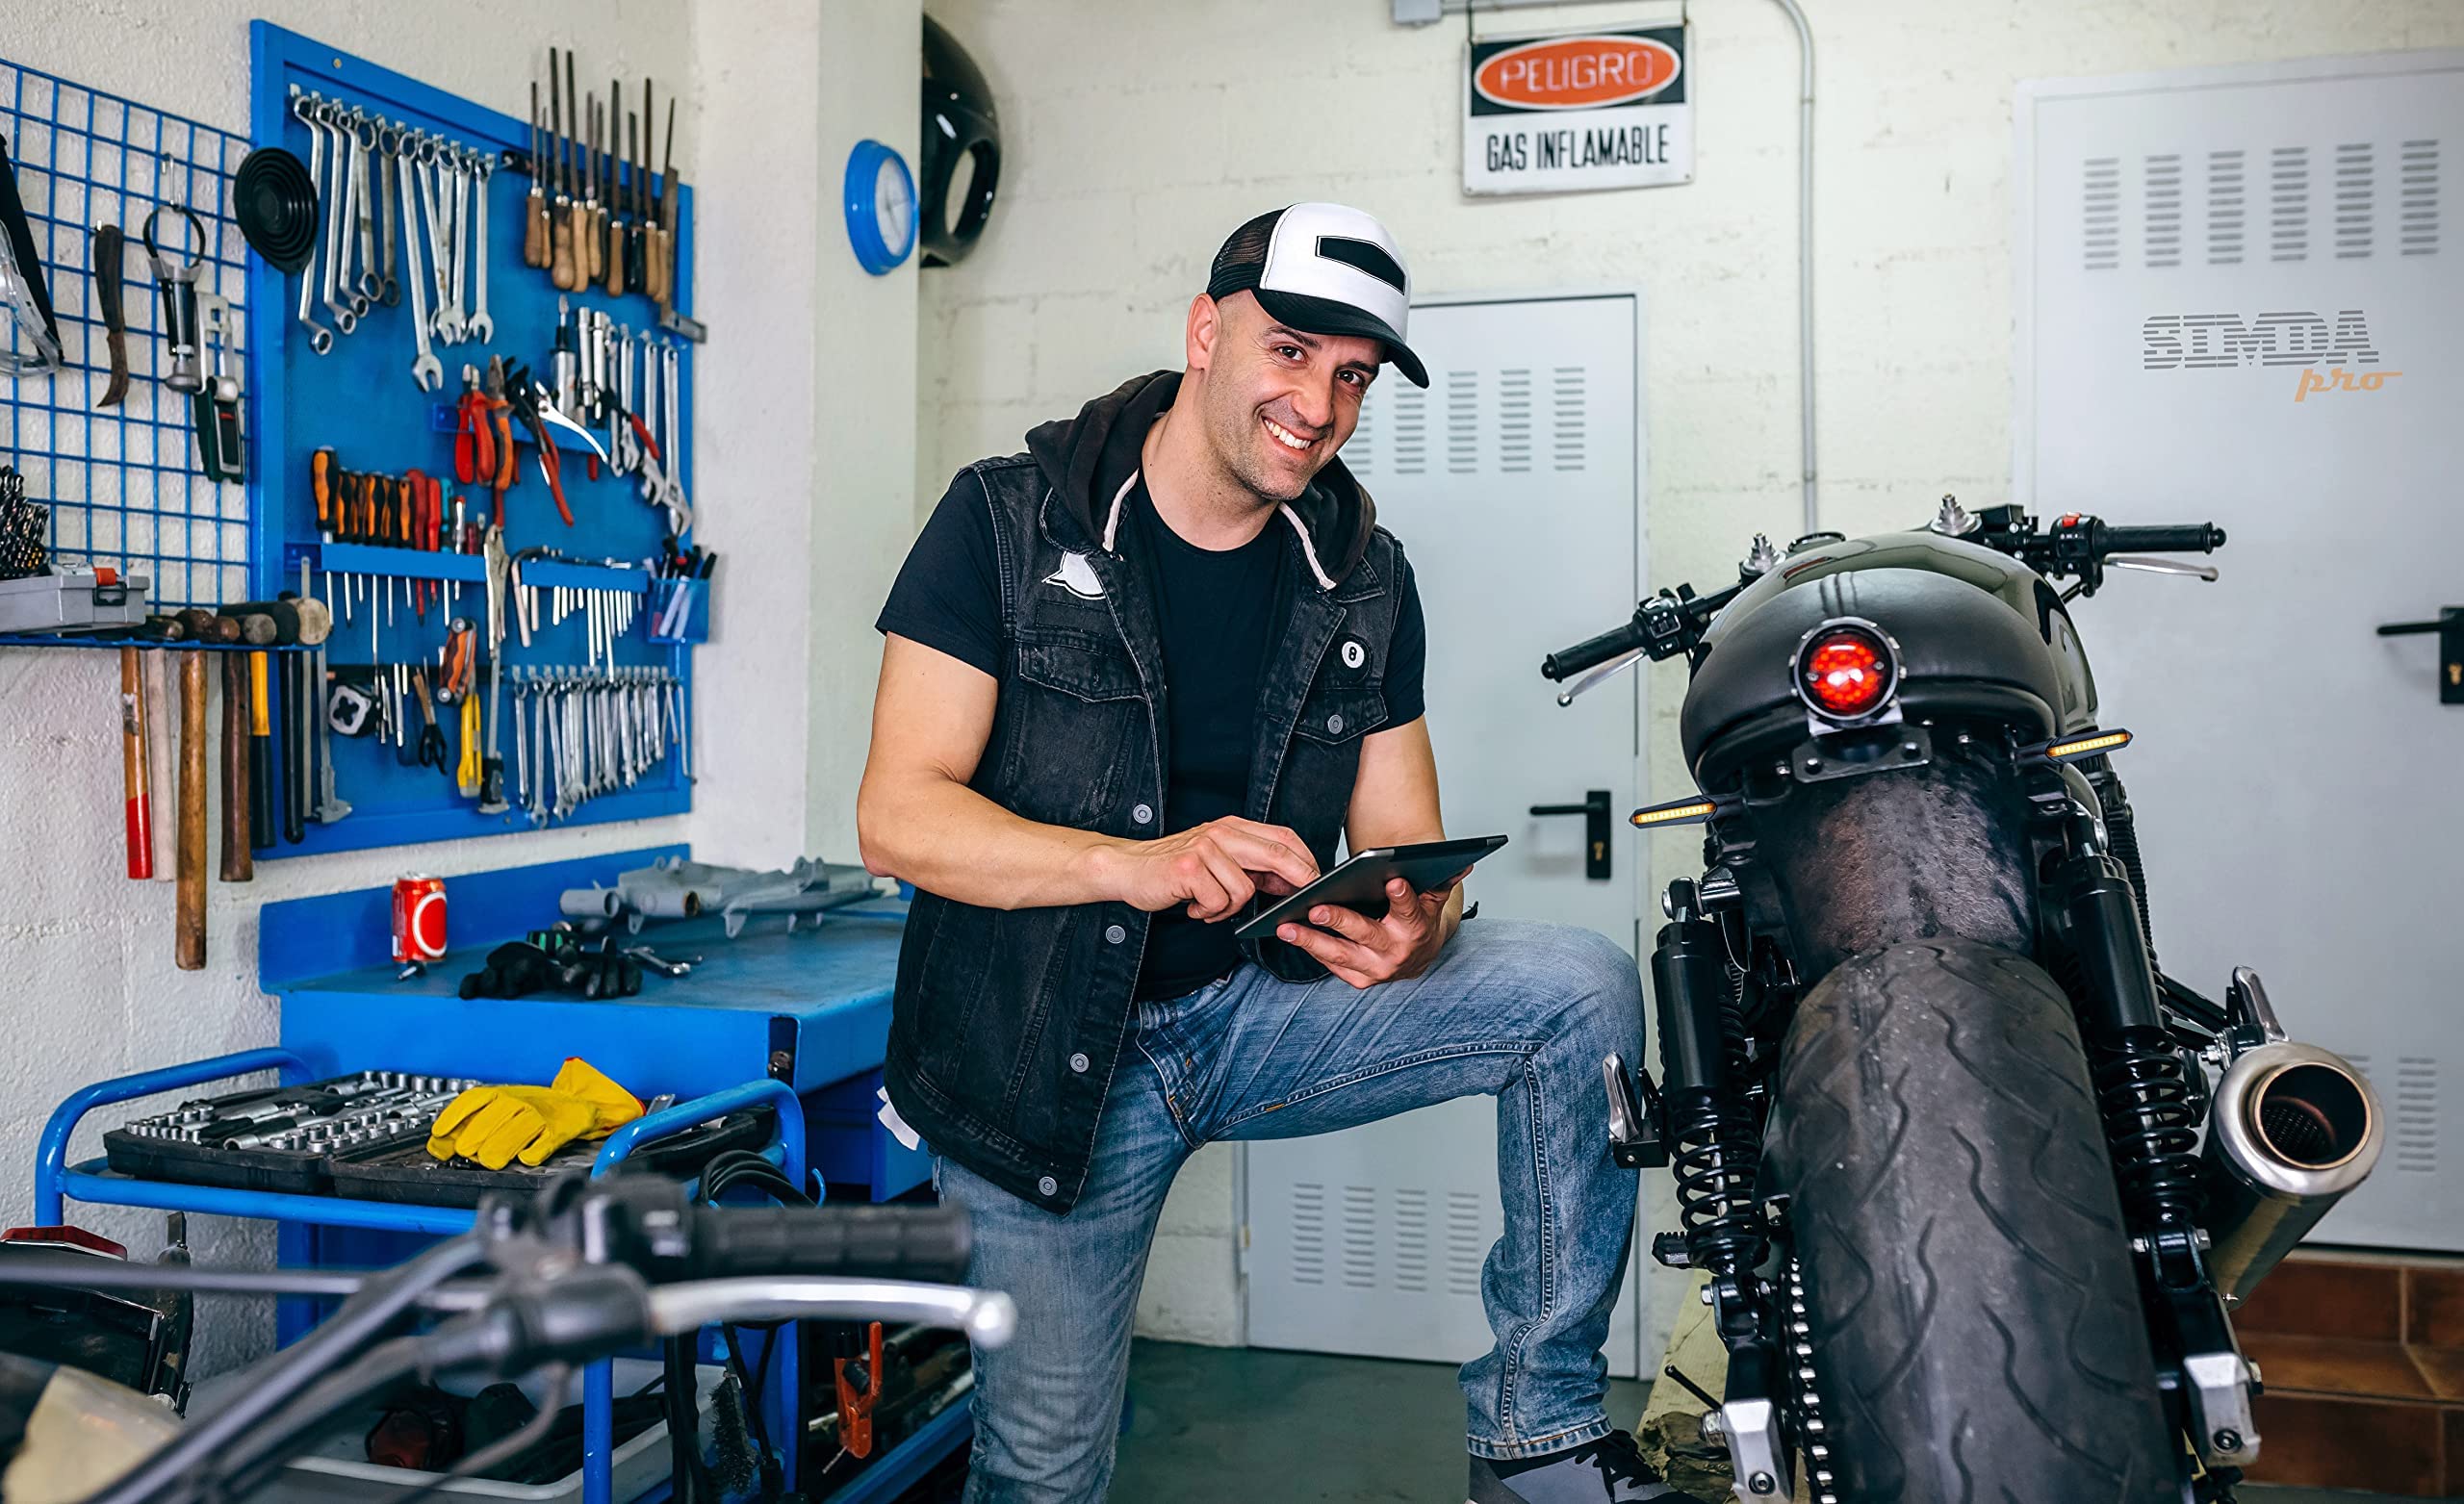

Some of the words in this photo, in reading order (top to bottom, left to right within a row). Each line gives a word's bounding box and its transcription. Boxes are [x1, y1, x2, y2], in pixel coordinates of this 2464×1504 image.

[1500, 50, 1654, 92] PELIGRO
[1487, 133, 1527, 172] GAS
[1537, 124, 1670, 169] INFLAMABLE
[1348, 646, 1357, 662] 8
